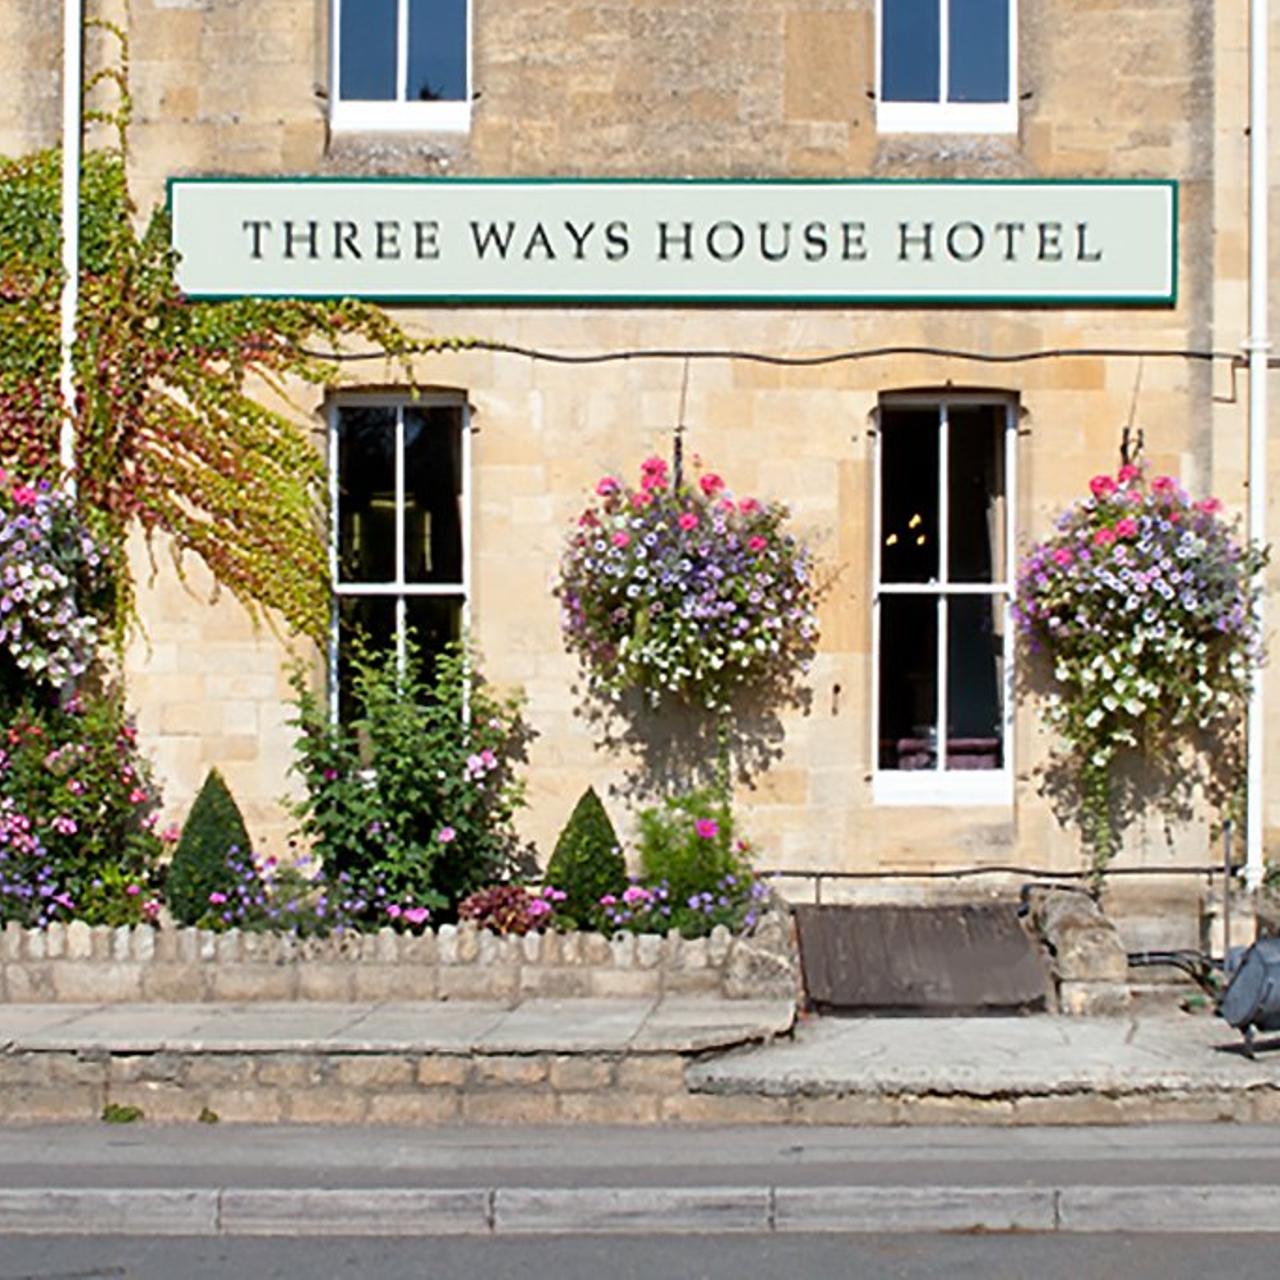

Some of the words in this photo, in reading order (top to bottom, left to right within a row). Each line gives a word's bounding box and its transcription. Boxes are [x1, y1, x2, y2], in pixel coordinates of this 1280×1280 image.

[241, 219, 441, 261] THREE
[468, 219, 631, 261] WAYS
[656, 220, 868, 263] HOUSE
[896, 220, 1103, 263] HOTEL
